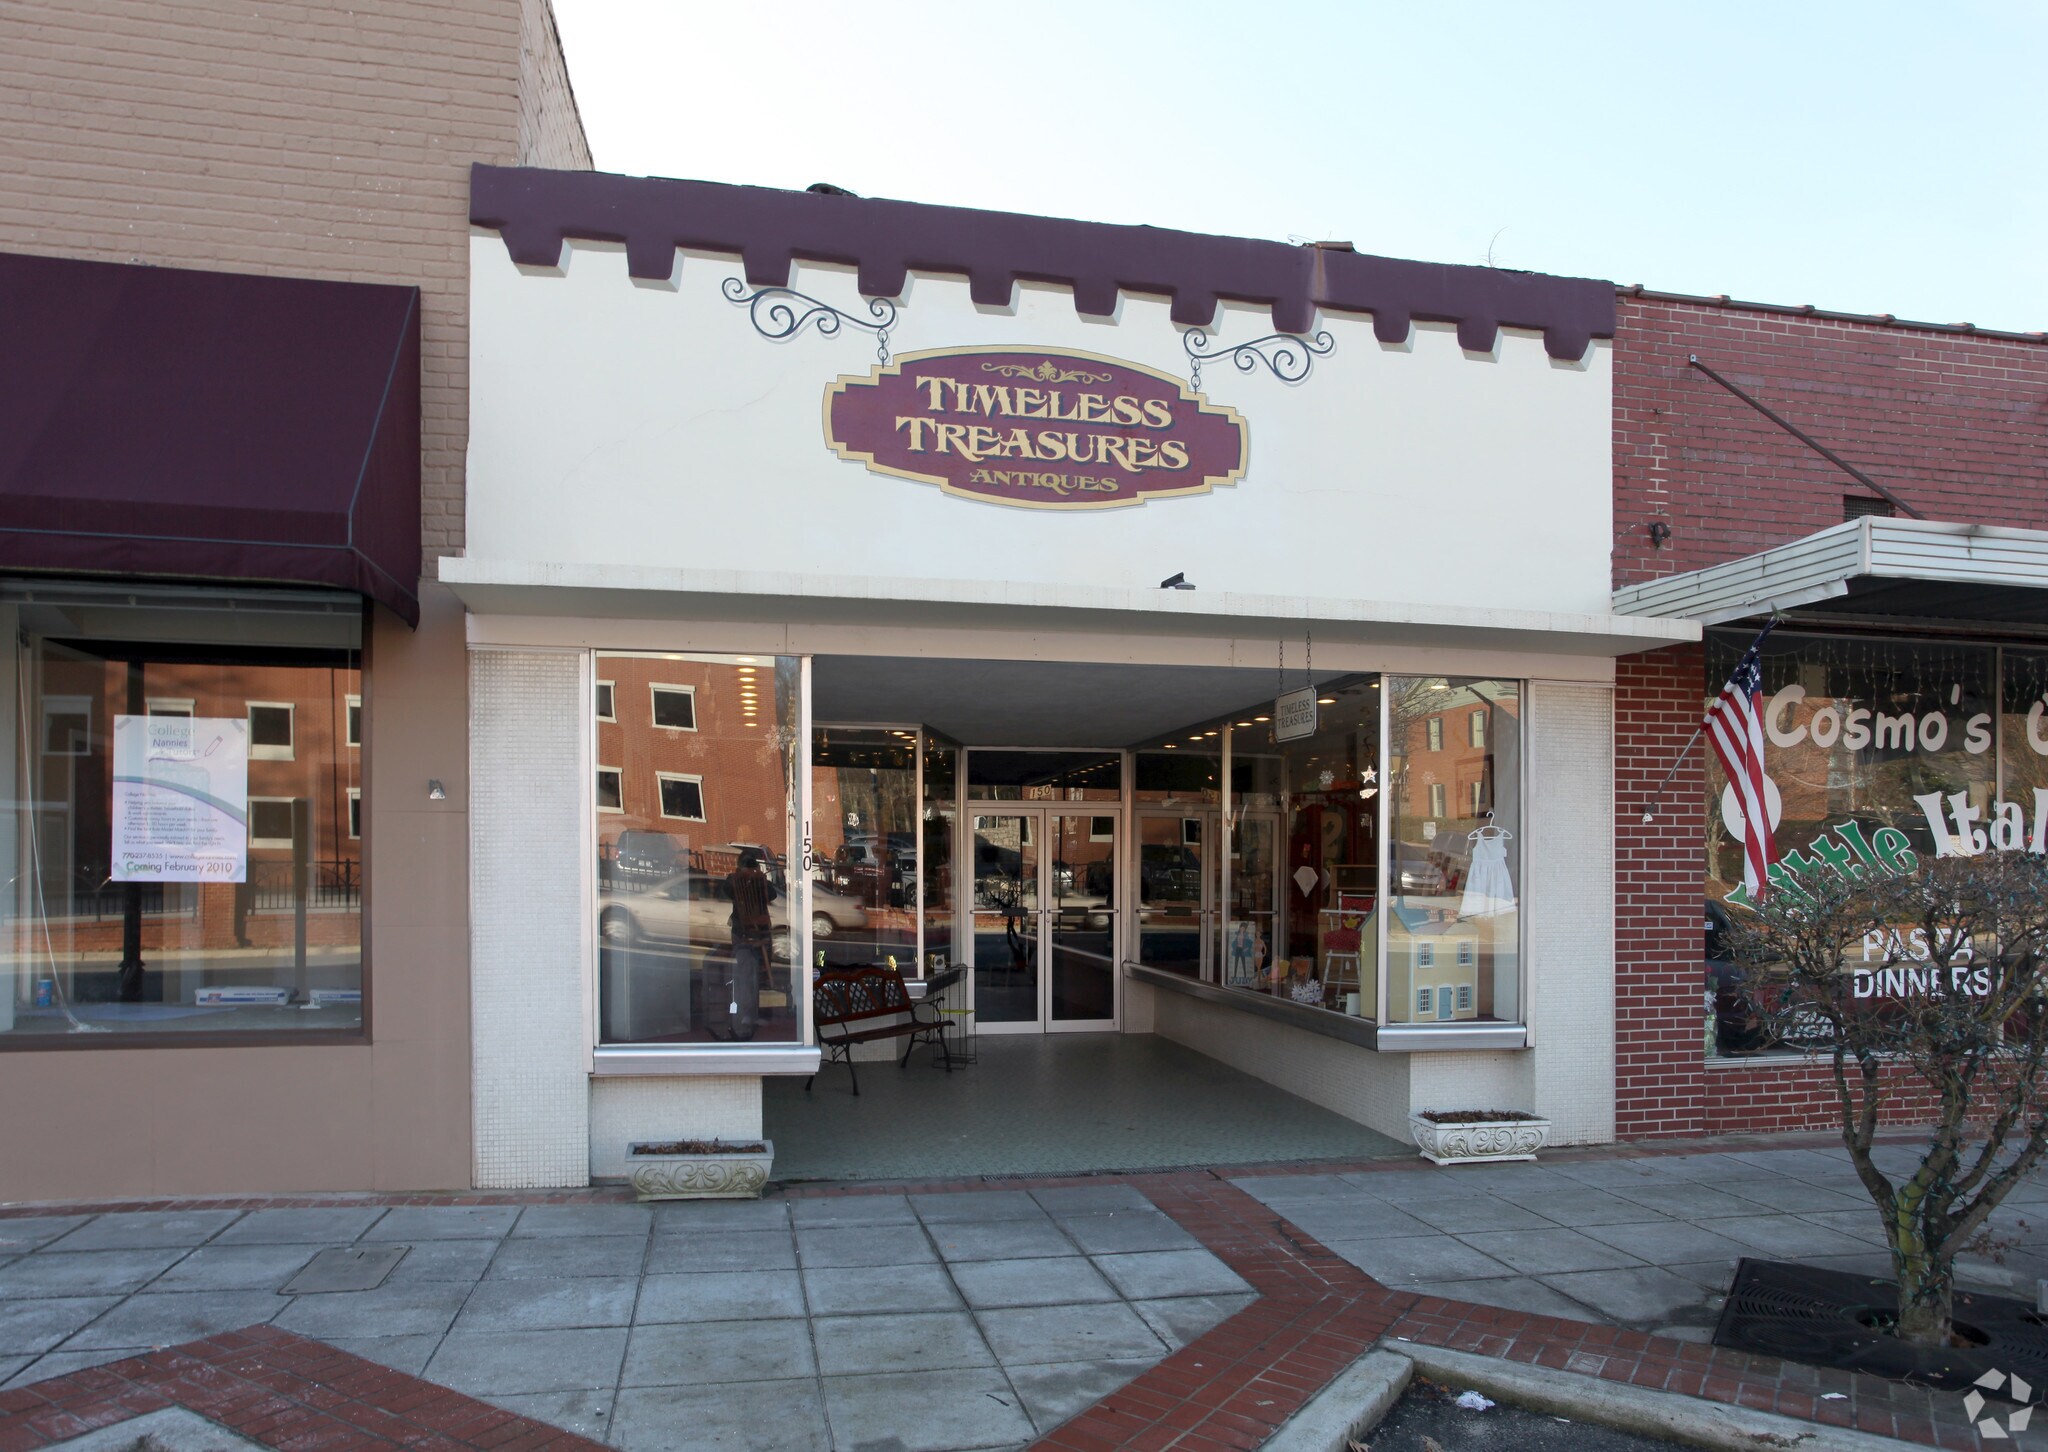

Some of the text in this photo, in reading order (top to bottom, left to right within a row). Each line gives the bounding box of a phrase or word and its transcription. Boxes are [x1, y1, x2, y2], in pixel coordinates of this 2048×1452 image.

[916, 375, 1173, 428] TIMELESS
[895, 416, 1190, 473] TREASURES
[971, 468, 1119, 495] ANTIQUES
[1278, 711, 1313, 729] TREASURES
[1280, 699, 1310, 717] TIMELESS
[1765, 684, 1992, 754] Cosmo's
[148, 724, 196, 736] College
[152, 738, 188, 748] Nannies
[1031, 785, 1051, 798] 150
[803, 821, 812, 871] 150
[126, 861, 233, 874] Coming February 2010
[1863, 927, 1973, 961] PASTA
[1854, 967, 1991, 998] DINNERS
